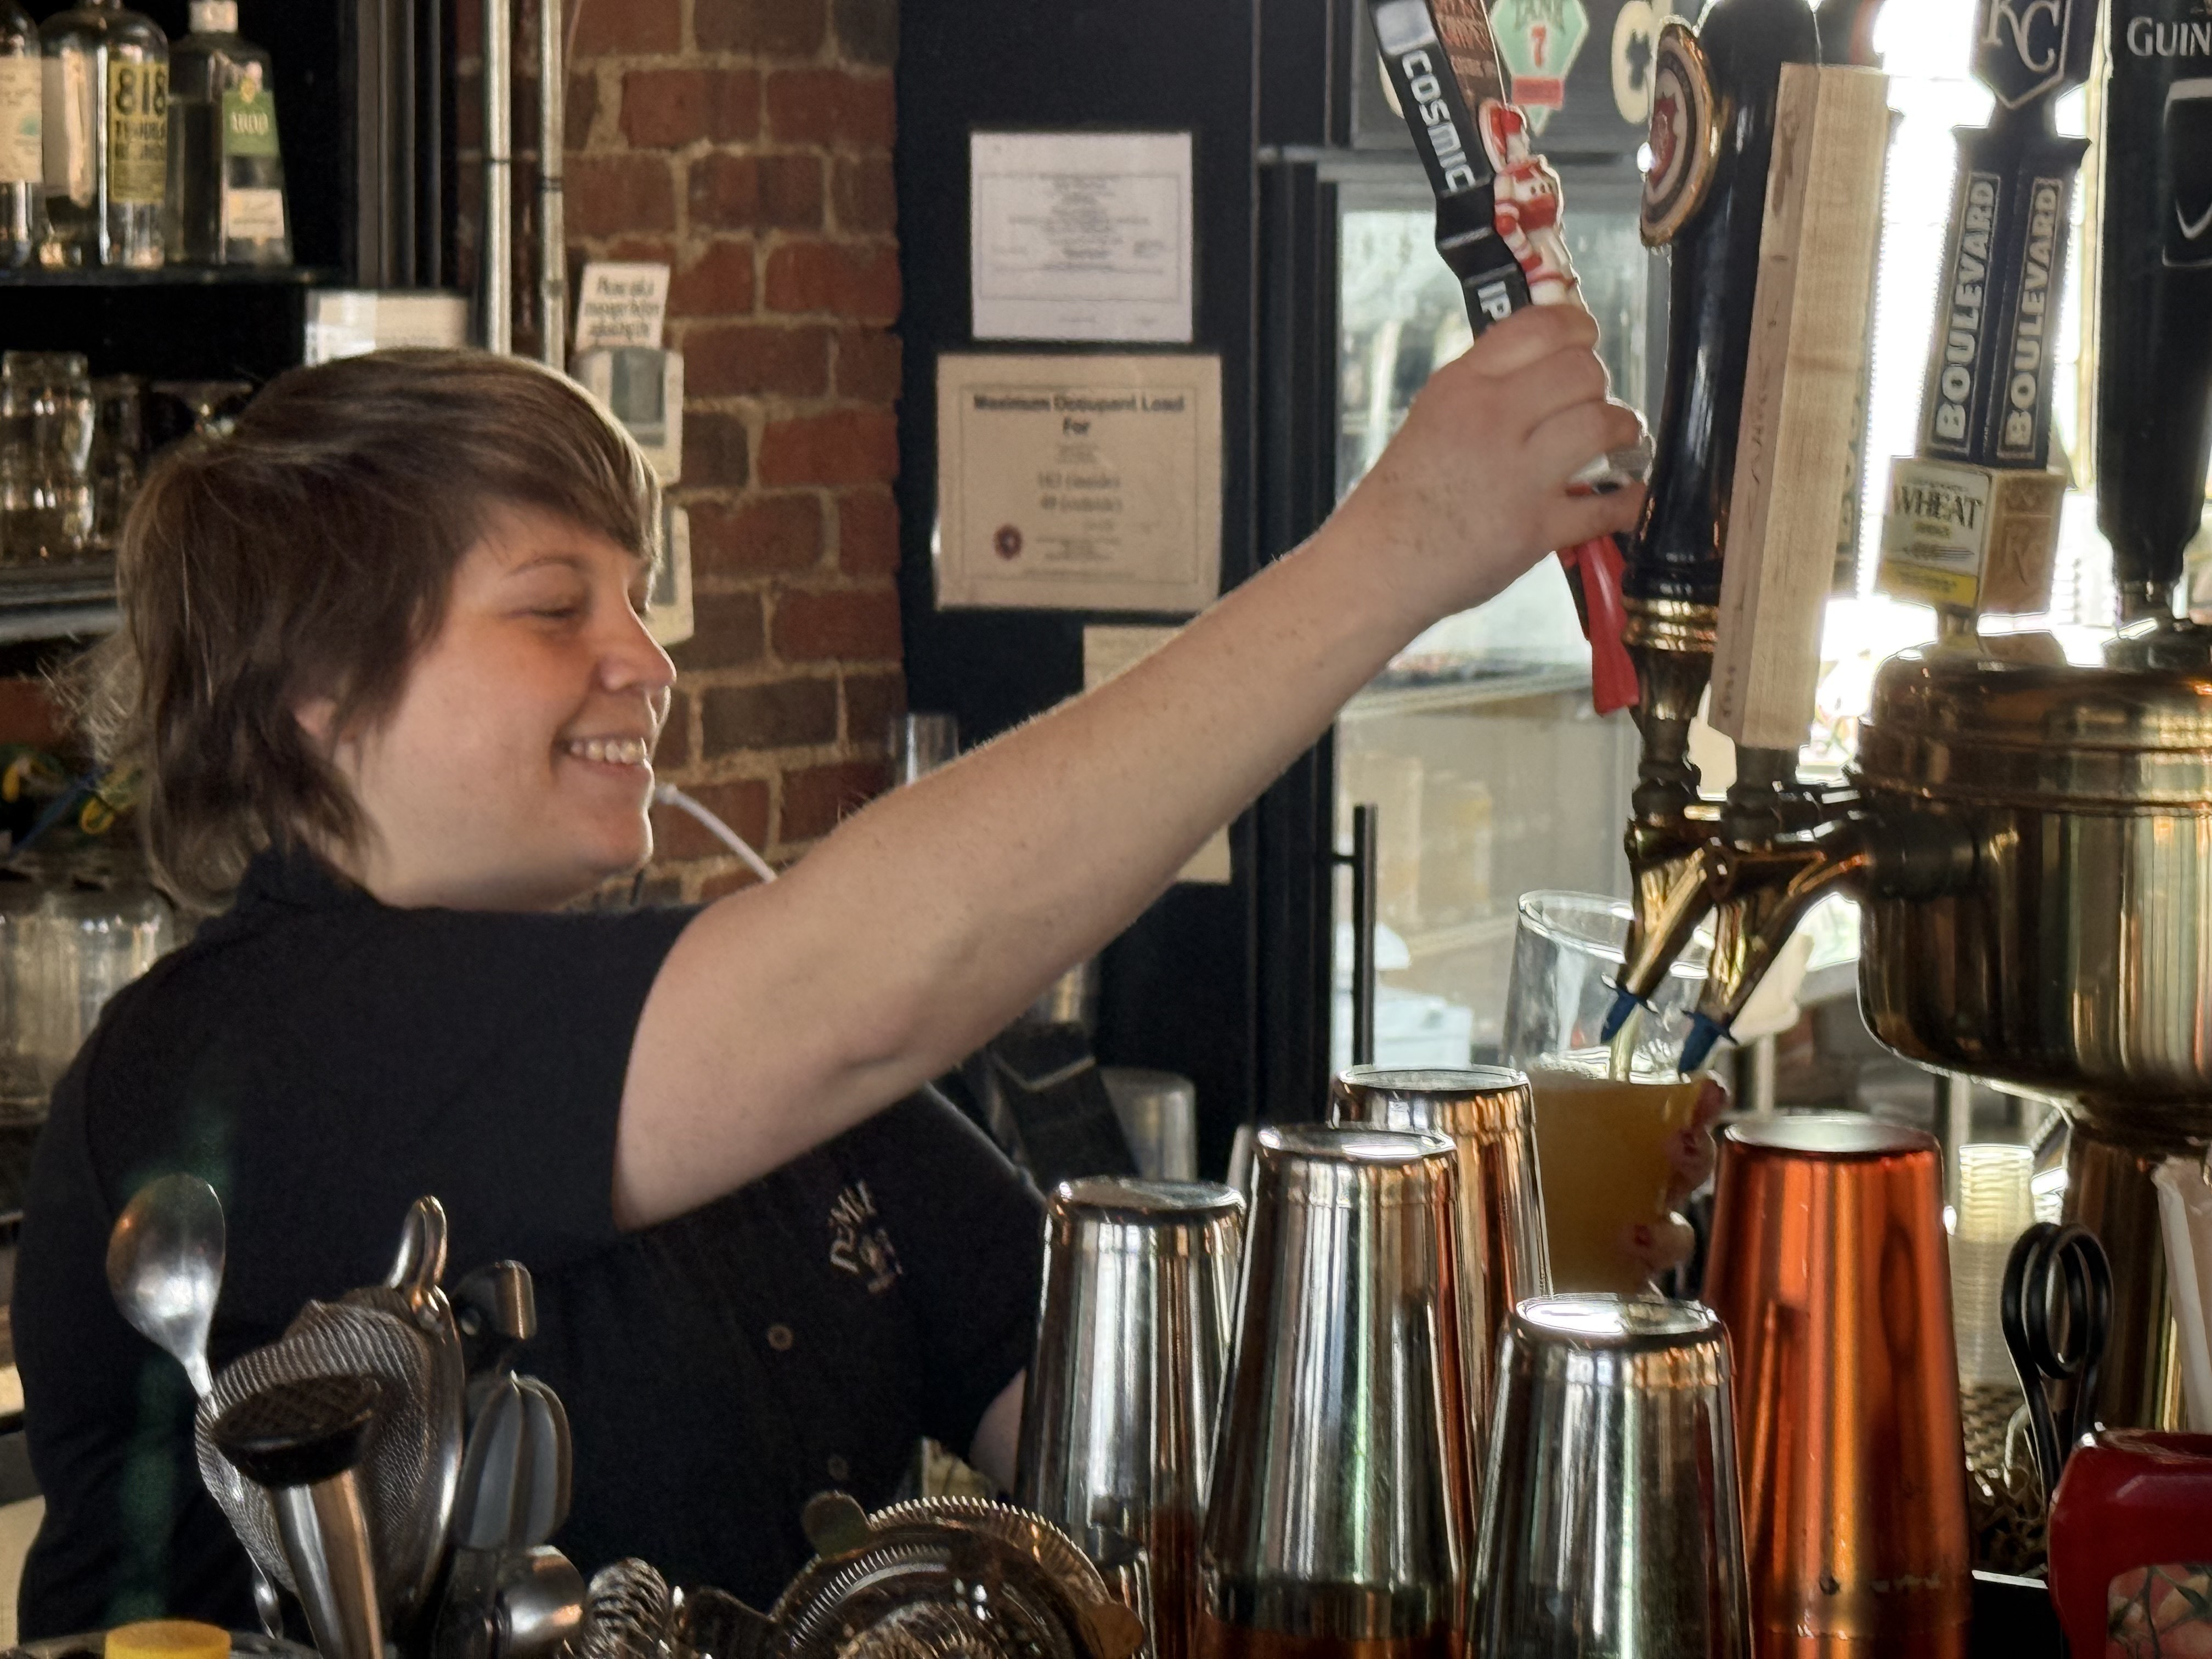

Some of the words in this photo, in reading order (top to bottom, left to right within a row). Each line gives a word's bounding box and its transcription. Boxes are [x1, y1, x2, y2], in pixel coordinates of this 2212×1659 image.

[1401, 49, 1477, 194] COSMIC
[1936, 180, 1995, 439] BOULEVARD
[2005, 187, 2057, 446] BOULEVARD
[1894, 485, 1984, 529] WHEAT
